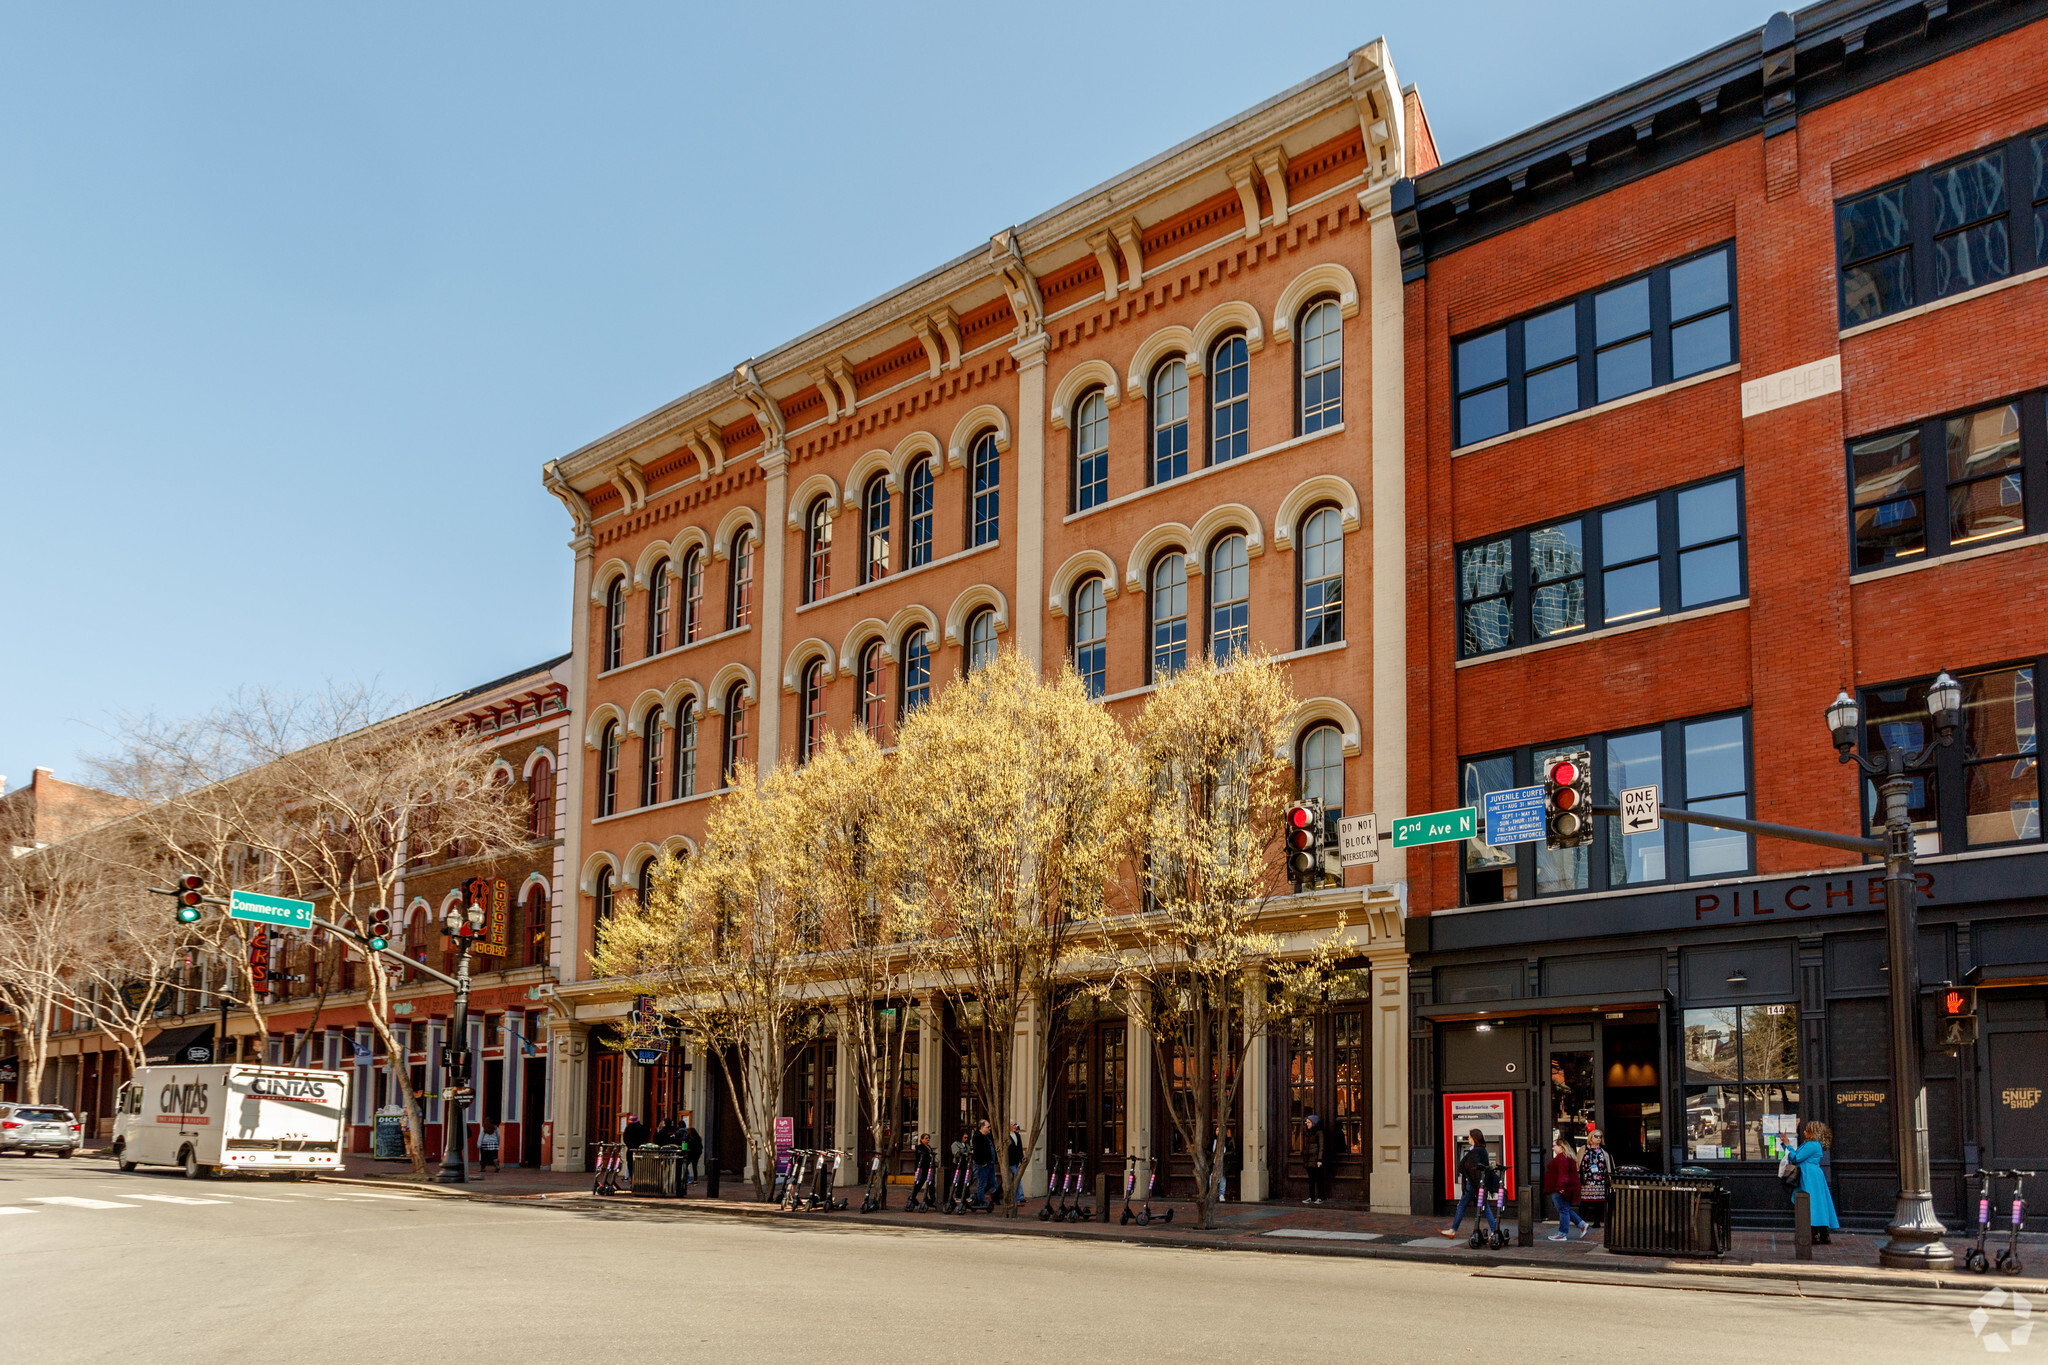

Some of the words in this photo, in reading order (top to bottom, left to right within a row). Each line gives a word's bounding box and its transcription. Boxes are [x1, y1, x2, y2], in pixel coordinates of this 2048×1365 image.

[1746, 363, 1836, 410] PILCHER
[1490, 792, 1520, 803] JUVENILE
[1625, 790, 1653, 804] ONE
[1625, 802, 1654, 816] WAY
[1342, 823, 1352, 833] DO
[1358, 819, 1373, 831] NOT
[1398, 821, 1421, 840] 2nd
[1428, 824, 1452, 836] Ave
[1459, 815, 1470, 832] N
[1519, 822, 1542, 830] MIDNIGHT
[1345, 836, 1372, 848] BLOCK
[1494, 835, 1517, 843] STRICTLY
[1518, 831, 1545, 840] ENFORCED
[1341, 849, 1378, 862] INTERSECTION
[1695, 872, 1935, 920] PILCHER
[231, 898, 291, 917] Commerce
[296, 908, 311, 920] St
[493, 880, 507, 944] COYOTE
[475, 942, 507, 957] UGLY
[1768, 1006, 1784, 1014] 144
[639, 1050, 655, 1059] BLUES
[251, 1076, 325, 1098] CINTAS
[160, 1074, 208, 1115] CINTAS
[1836, 1093, 1885, 1104] SNUFFSHOP
[2002, 1089, 2042, 1104] SNUFF
[2010, 1100, 2035, 1109] SHOP
